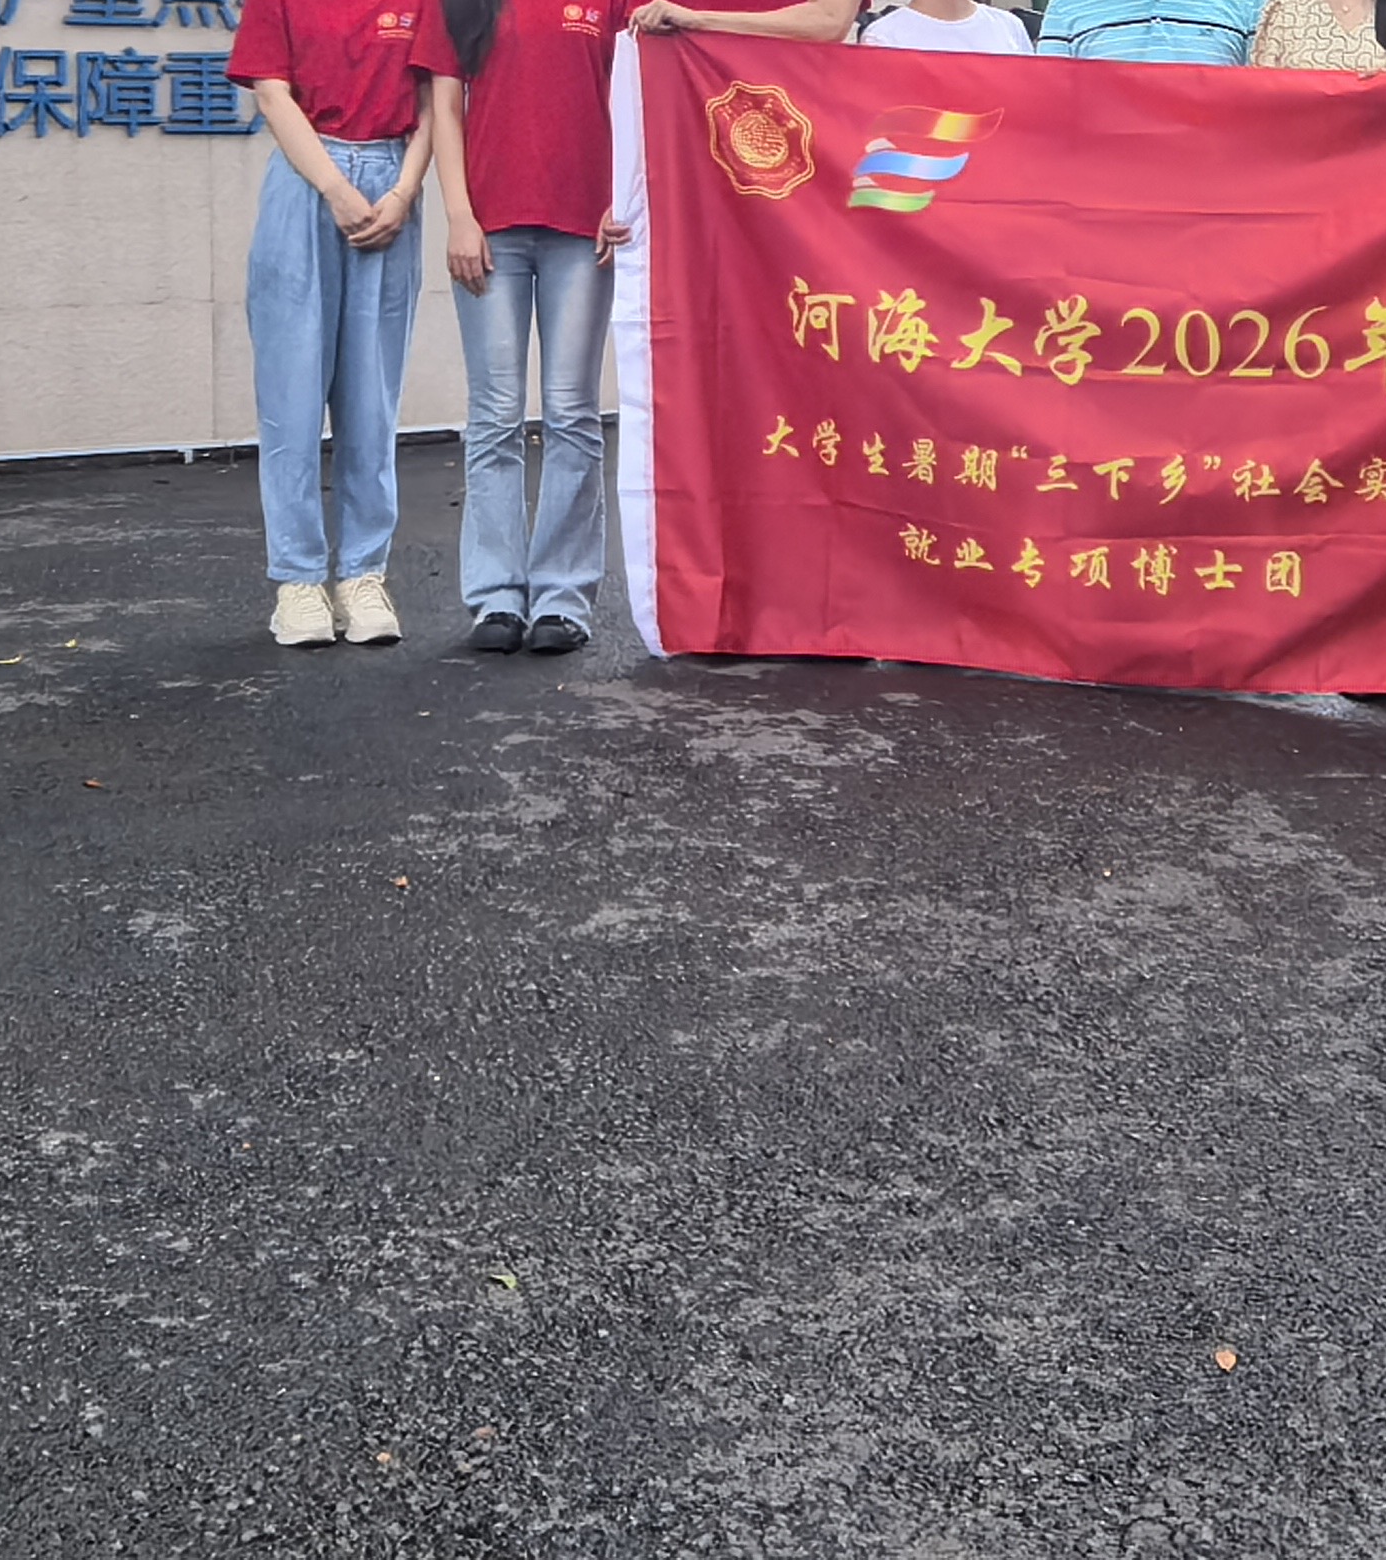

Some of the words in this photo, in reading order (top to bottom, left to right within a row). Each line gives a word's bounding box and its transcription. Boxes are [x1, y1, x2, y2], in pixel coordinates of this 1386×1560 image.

[898, 522, 1303, 597] 就业专项博士团
